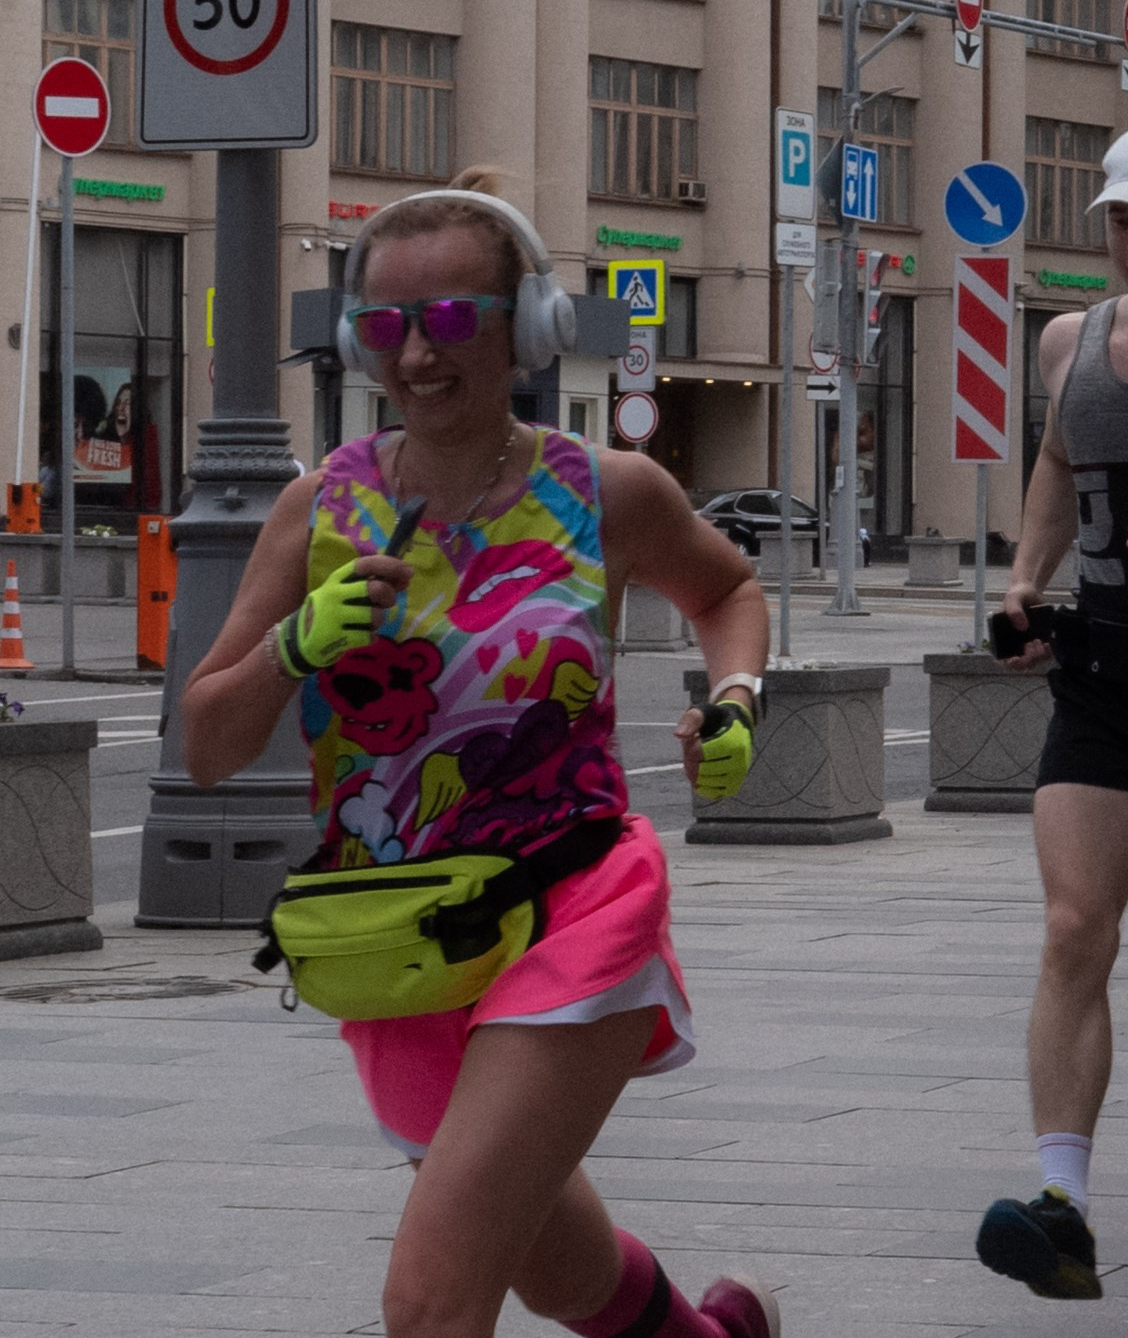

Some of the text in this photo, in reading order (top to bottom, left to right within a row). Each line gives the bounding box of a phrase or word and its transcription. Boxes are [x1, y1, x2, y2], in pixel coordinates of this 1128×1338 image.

[787, 116, 805, 127] ЗОНА
[789, 139, 806, 177] P
[629, 354, 644, 367] 30
